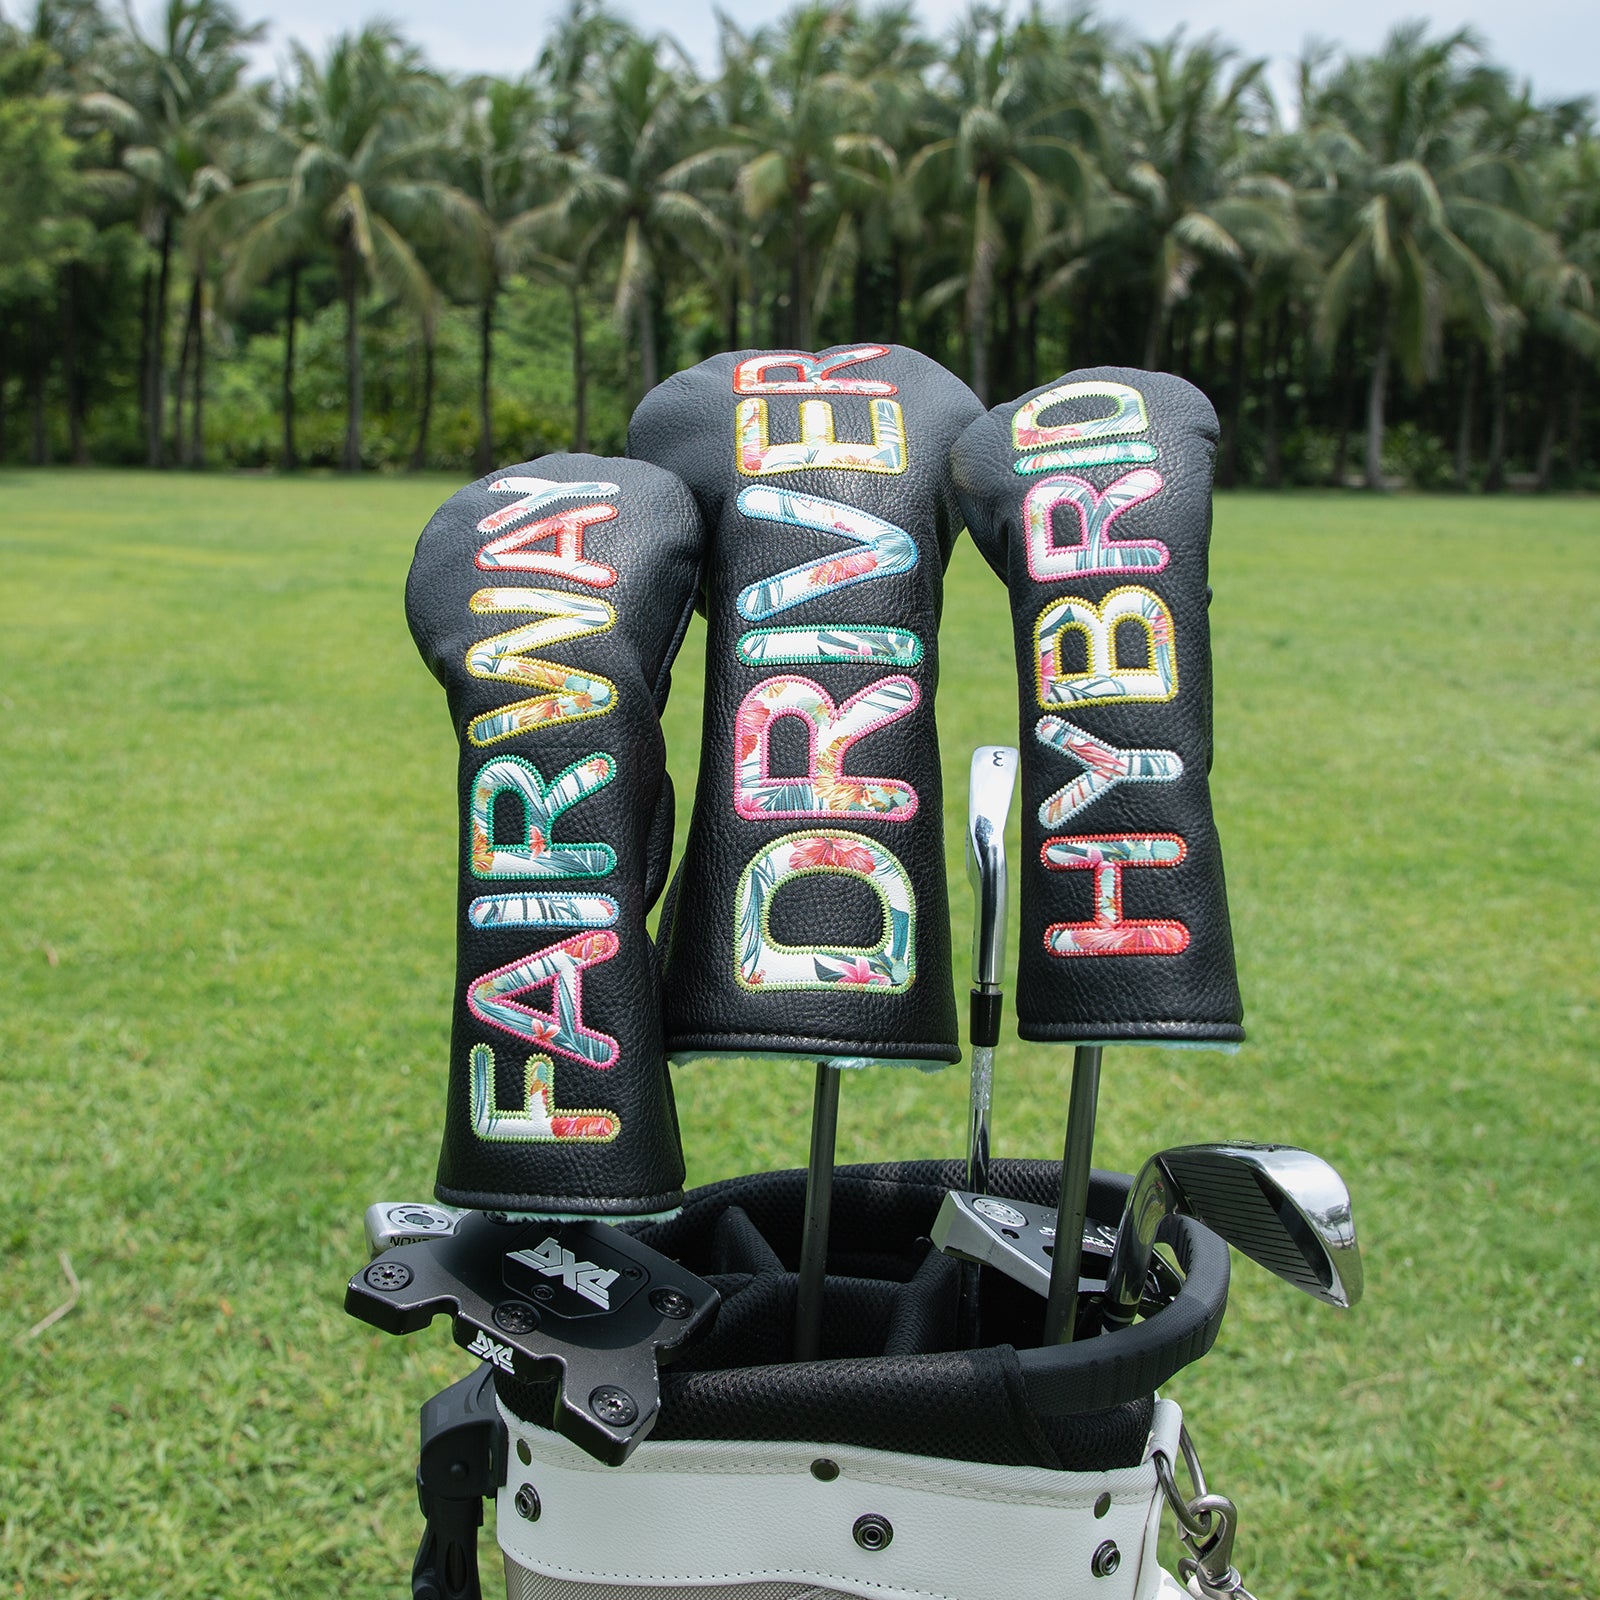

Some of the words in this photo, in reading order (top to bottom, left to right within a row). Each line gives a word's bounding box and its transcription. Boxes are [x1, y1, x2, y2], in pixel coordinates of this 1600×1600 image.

[465, 477, 621, 1144] FAIRWAY
[734, 345, 924, 994] DRIVER
[992, 751, 1005, 767] 3
[1012, 380, 1191, 958] HYBRID
[467, 1330, 515, 1374] PXG
[506, 1237, 620, 1310] PXG
